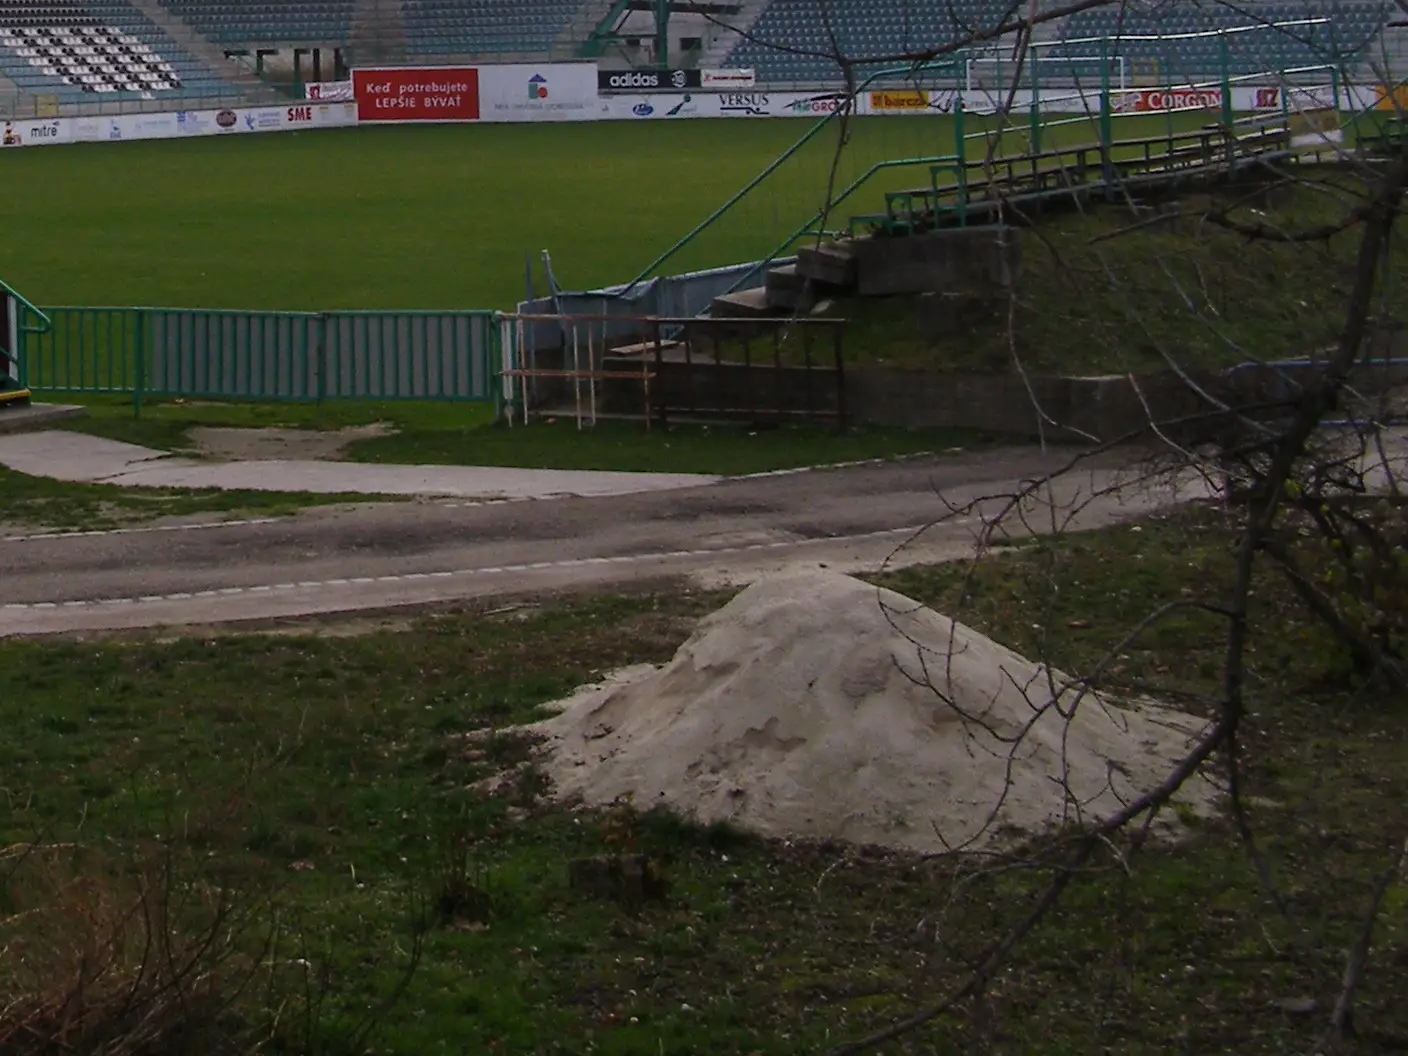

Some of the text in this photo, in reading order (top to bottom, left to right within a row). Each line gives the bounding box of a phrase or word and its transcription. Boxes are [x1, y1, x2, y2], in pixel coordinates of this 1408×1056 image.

[609, 72, 658, 88] adidas
[366, 81, 391, 94] Keď
[399, 81, 468, 96] potrebujete
[375, 95, 416, 108] LEPŠIE
[719, 94, 770, 106] VERSUS
[287, 107, 312, 122] SME
[30, 124, 58, 138] mitre
